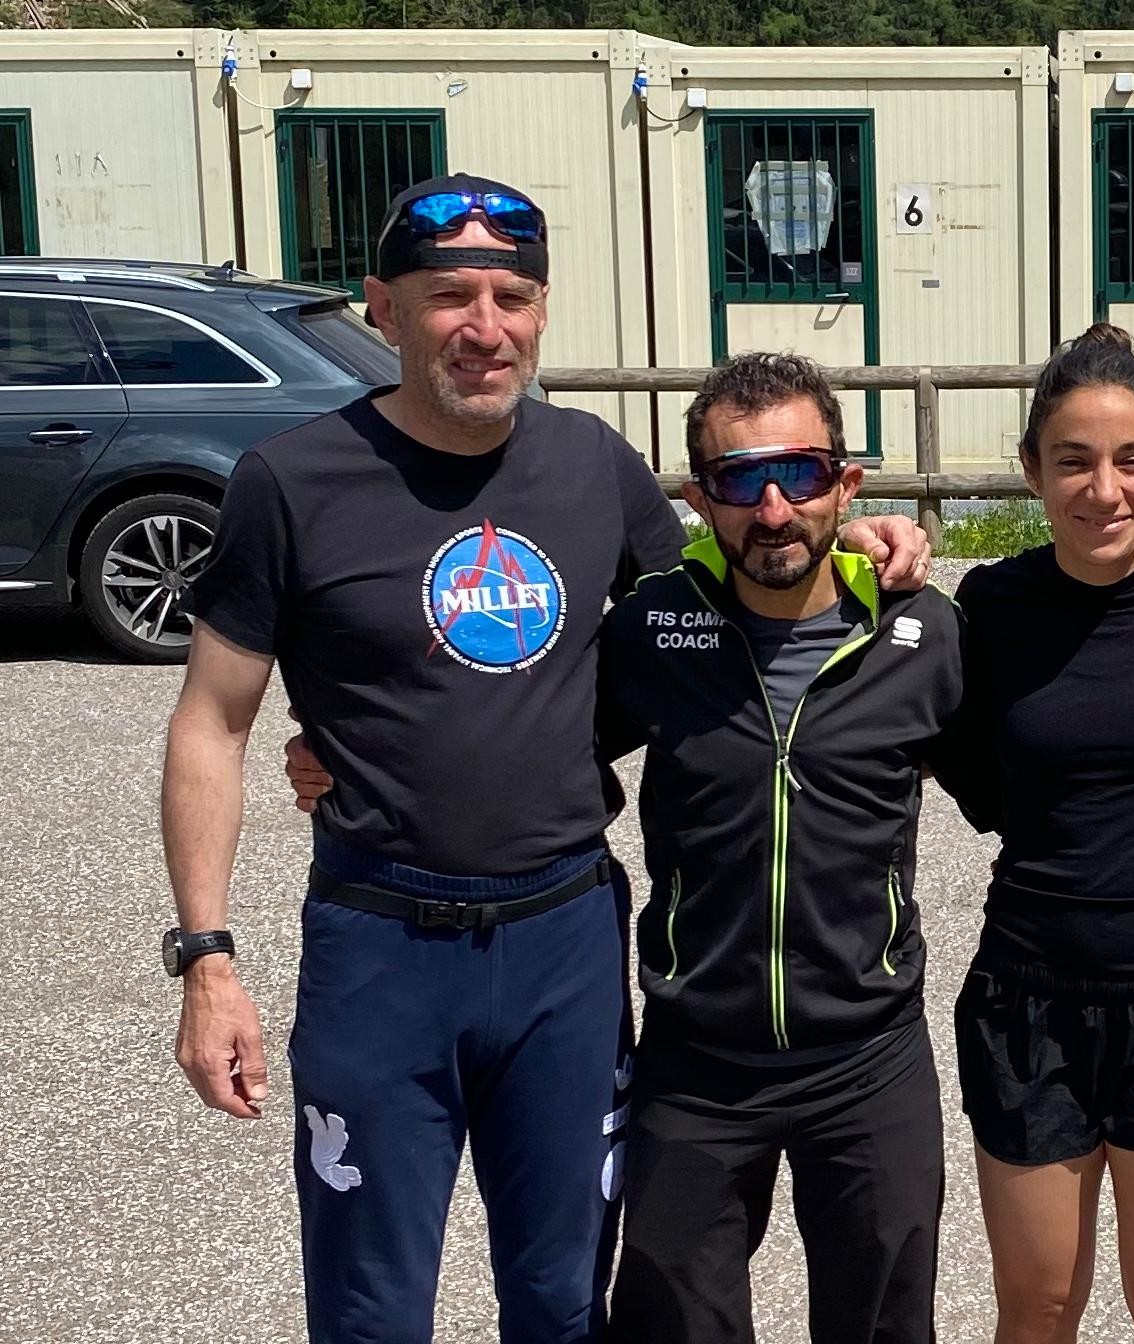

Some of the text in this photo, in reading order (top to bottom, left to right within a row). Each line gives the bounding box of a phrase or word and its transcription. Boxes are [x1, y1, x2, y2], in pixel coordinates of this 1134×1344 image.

[904, 194, 924, 227] 6
[440, 583, 550, 615] MILLET
[647, 610, 677, 626] FIS
[656, 633, 720, 649] COACH
